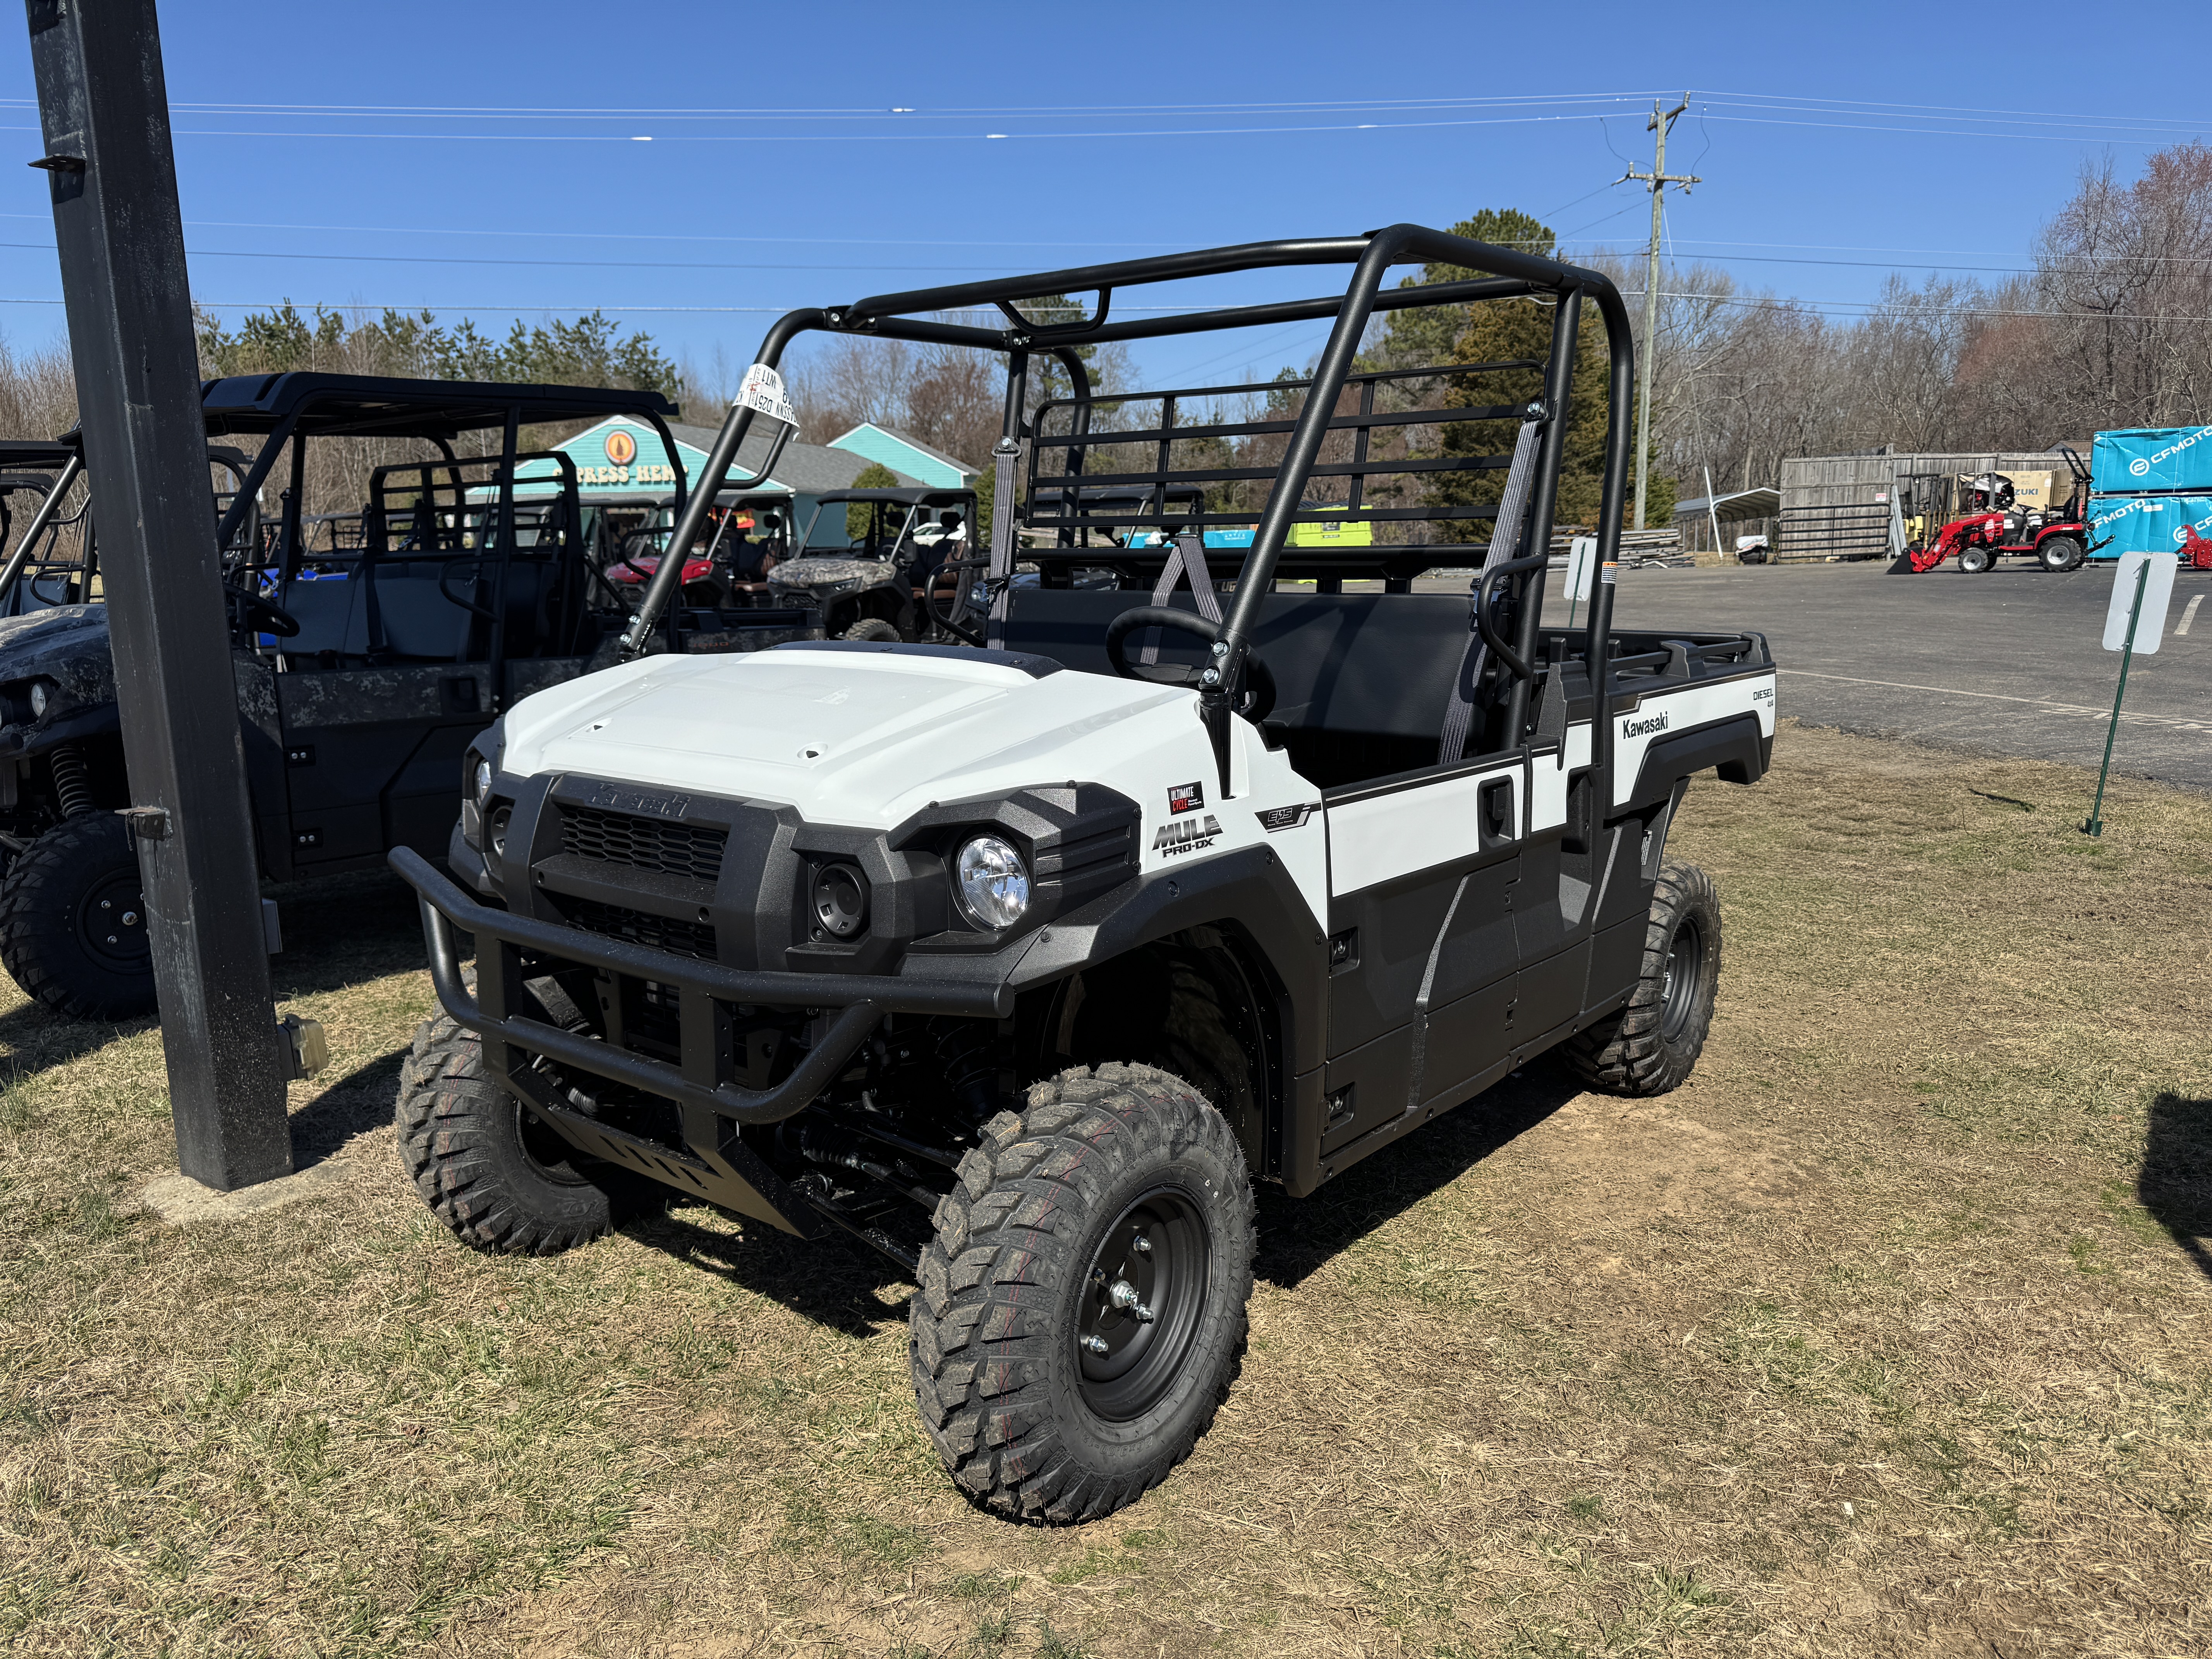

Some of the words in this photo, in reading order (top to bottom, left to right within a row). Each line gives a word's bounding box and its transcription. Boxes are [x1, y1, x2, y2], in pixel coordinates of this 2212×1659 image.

[2151, 426, 2212, 464] CFMOTO
[552, 466, 629, 483] PRESS
[2093, 498, 2145, 528] FMOTO
[1753, 688, 1773, 701] DIESEL
[1623, 711, 1668, 739] Kawasaki
[589, 783, 691, 817] Kawasaki
[1171, 786, 1194, 801] ULTIMATE
[1173, 799, 1188, 811] CYCLE
[1268, 808, 1293, 823] EPS
[1152, 814, 1224, 851] MULE
[1163, 836, 1216, 858] PRO-DX
[1200, 1235, 1242, 1394] DURO
[1082, 1432, 1153, 1456] 26x9.00-12
